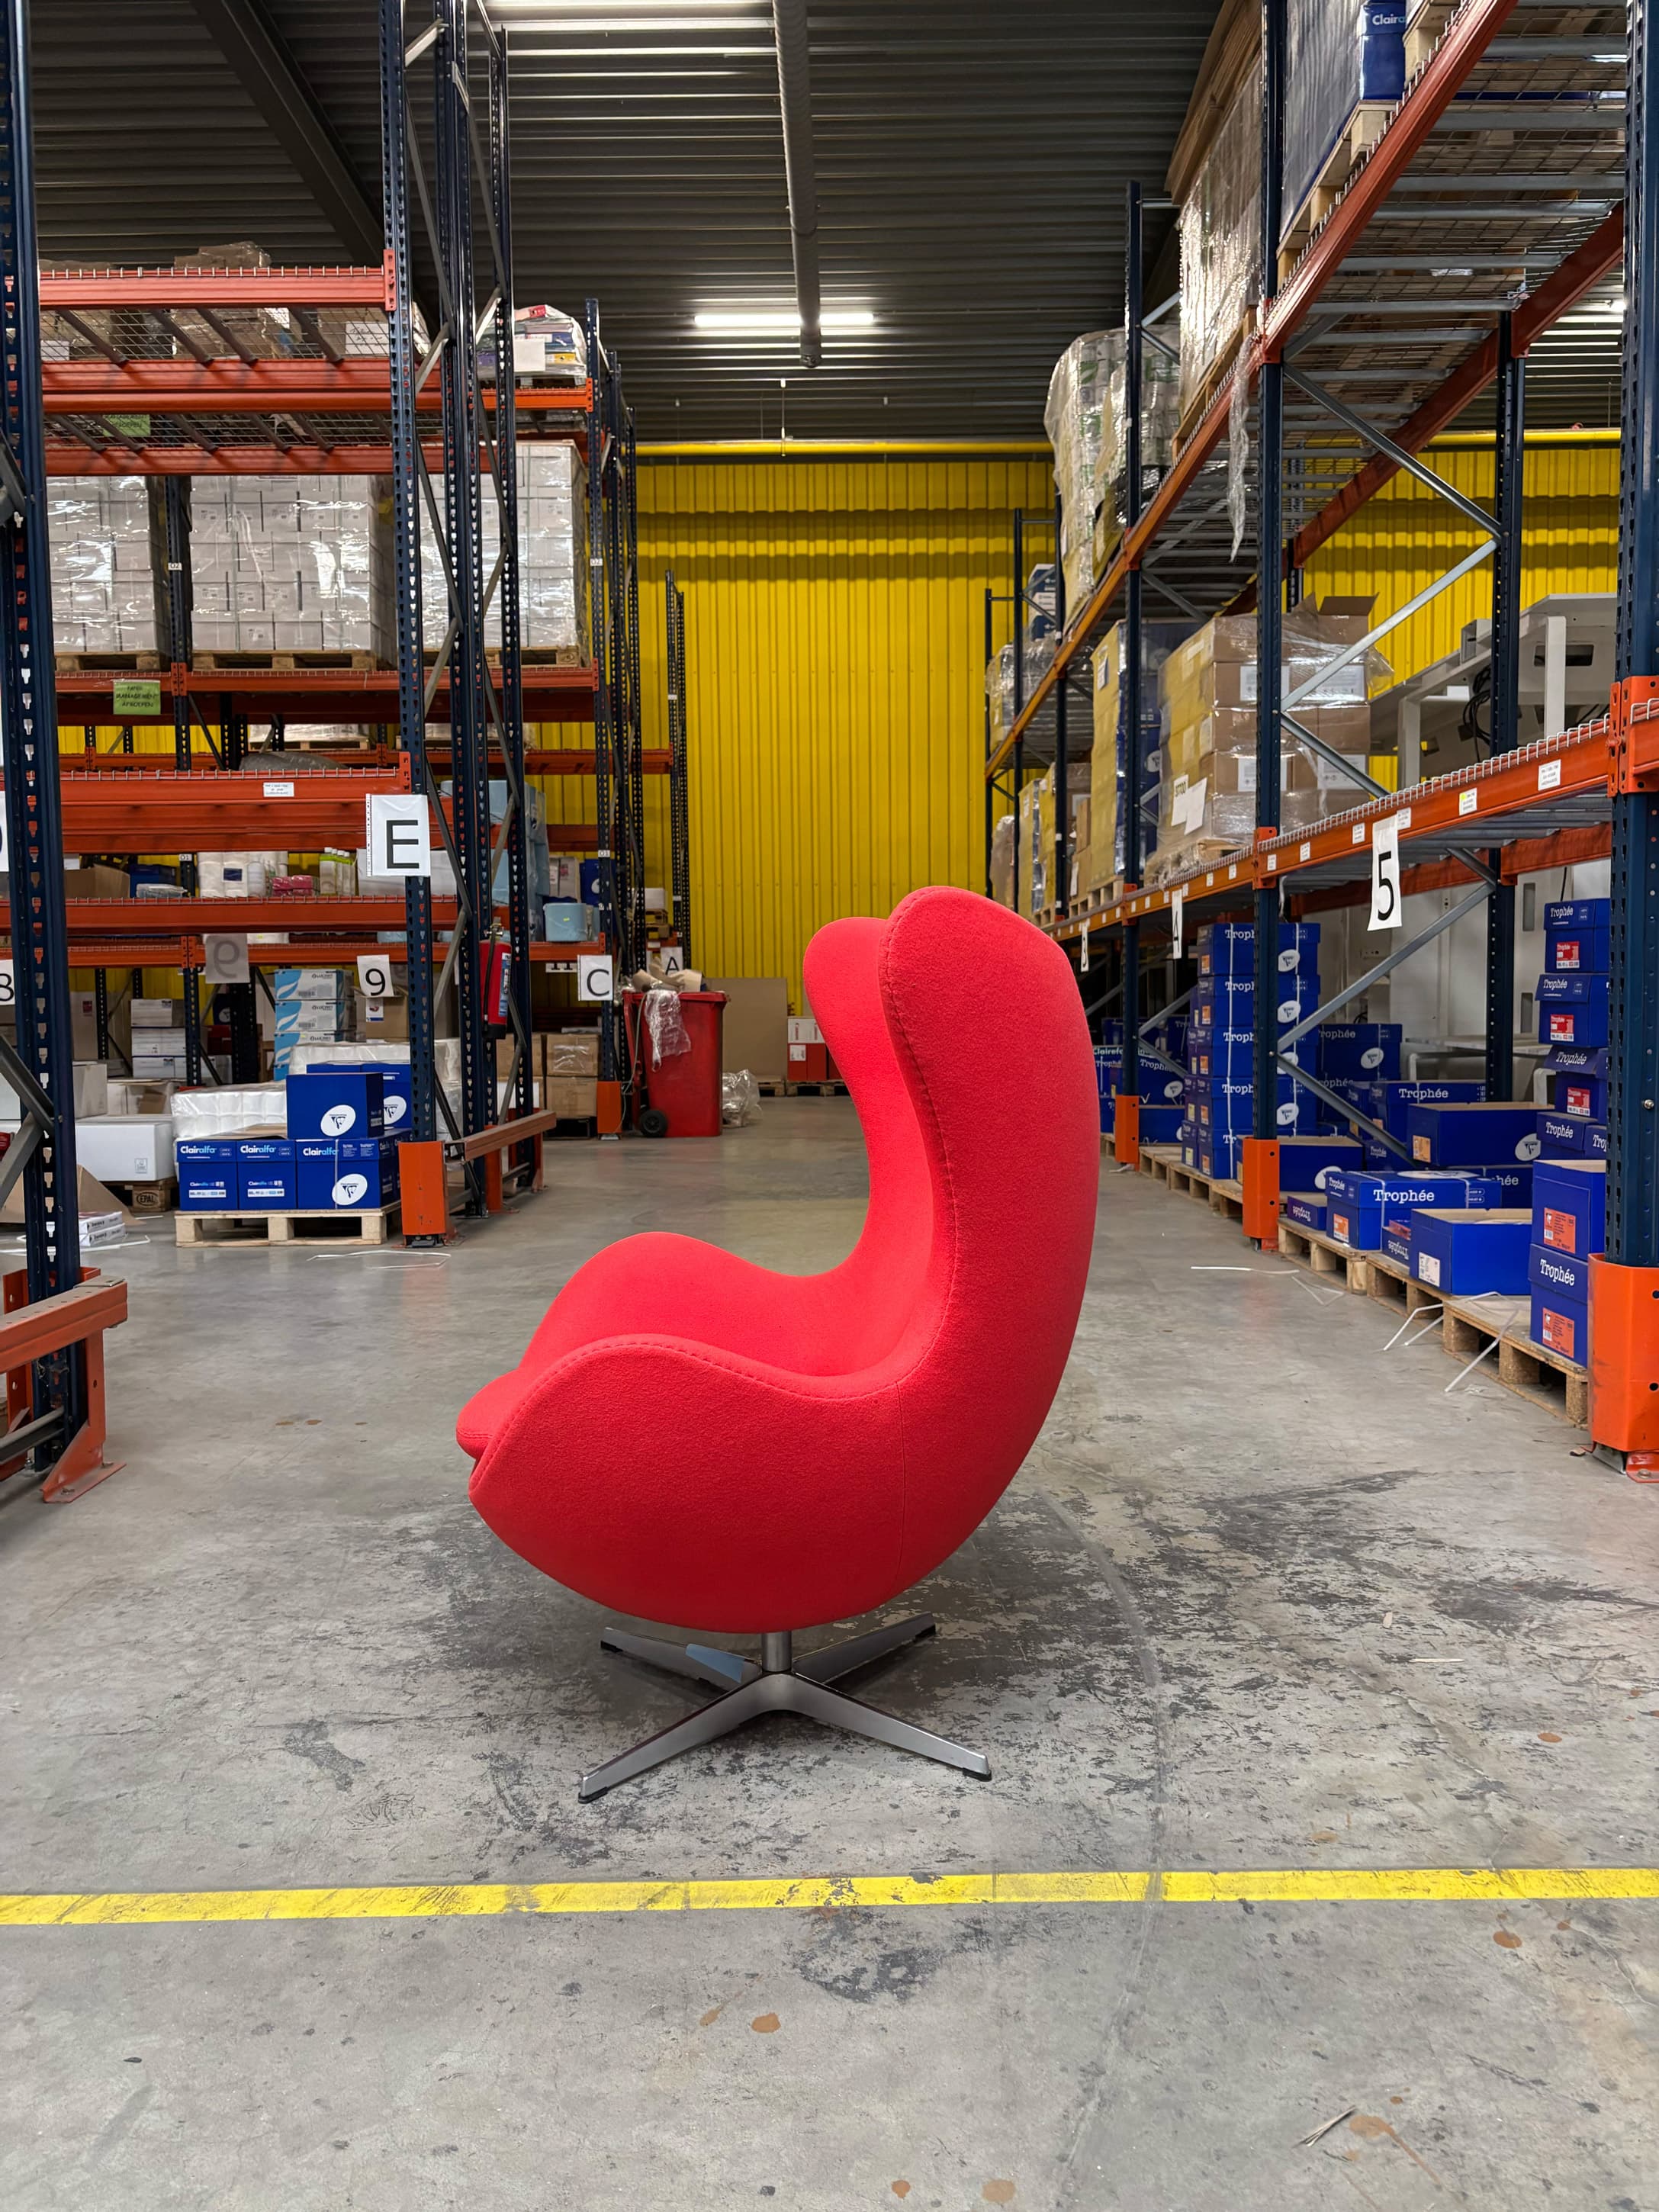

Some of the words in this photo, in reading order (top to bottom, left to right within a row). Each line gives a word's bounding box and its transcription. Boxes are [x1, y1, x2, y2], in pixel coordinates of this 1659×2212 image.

[1372, 14, 1406, 25] Claira
[386, 820, 420, 869] E
[1378, 850, 1394, 921] 5
[1550, 907, 1574, 918] Trophée
[1172, 910, 1180, 953] 4
[1082, 935, 1088, 969] 3
[666, 956, 679, 975] A
[365, 968, 386, 996] 9
[587, 969, 609, 996] C
[1543, 979, 1567, 989] Trophée
[1319, 1029, 1355, 1039] rophée
[1555, 1051, 1587, 1066] Trophée
[1398, 1088, 1449, 1100] Trophée
[1546, 1121, 1574, 1139] Trophée
[180, 1146, 216, 1154] Clairalfa
[240, 1144, 276, 1153] Clairalfa
[1373, 1189, 1435, 1204] Trophée
[1540, 1259, 1575, 1287] Trophée
